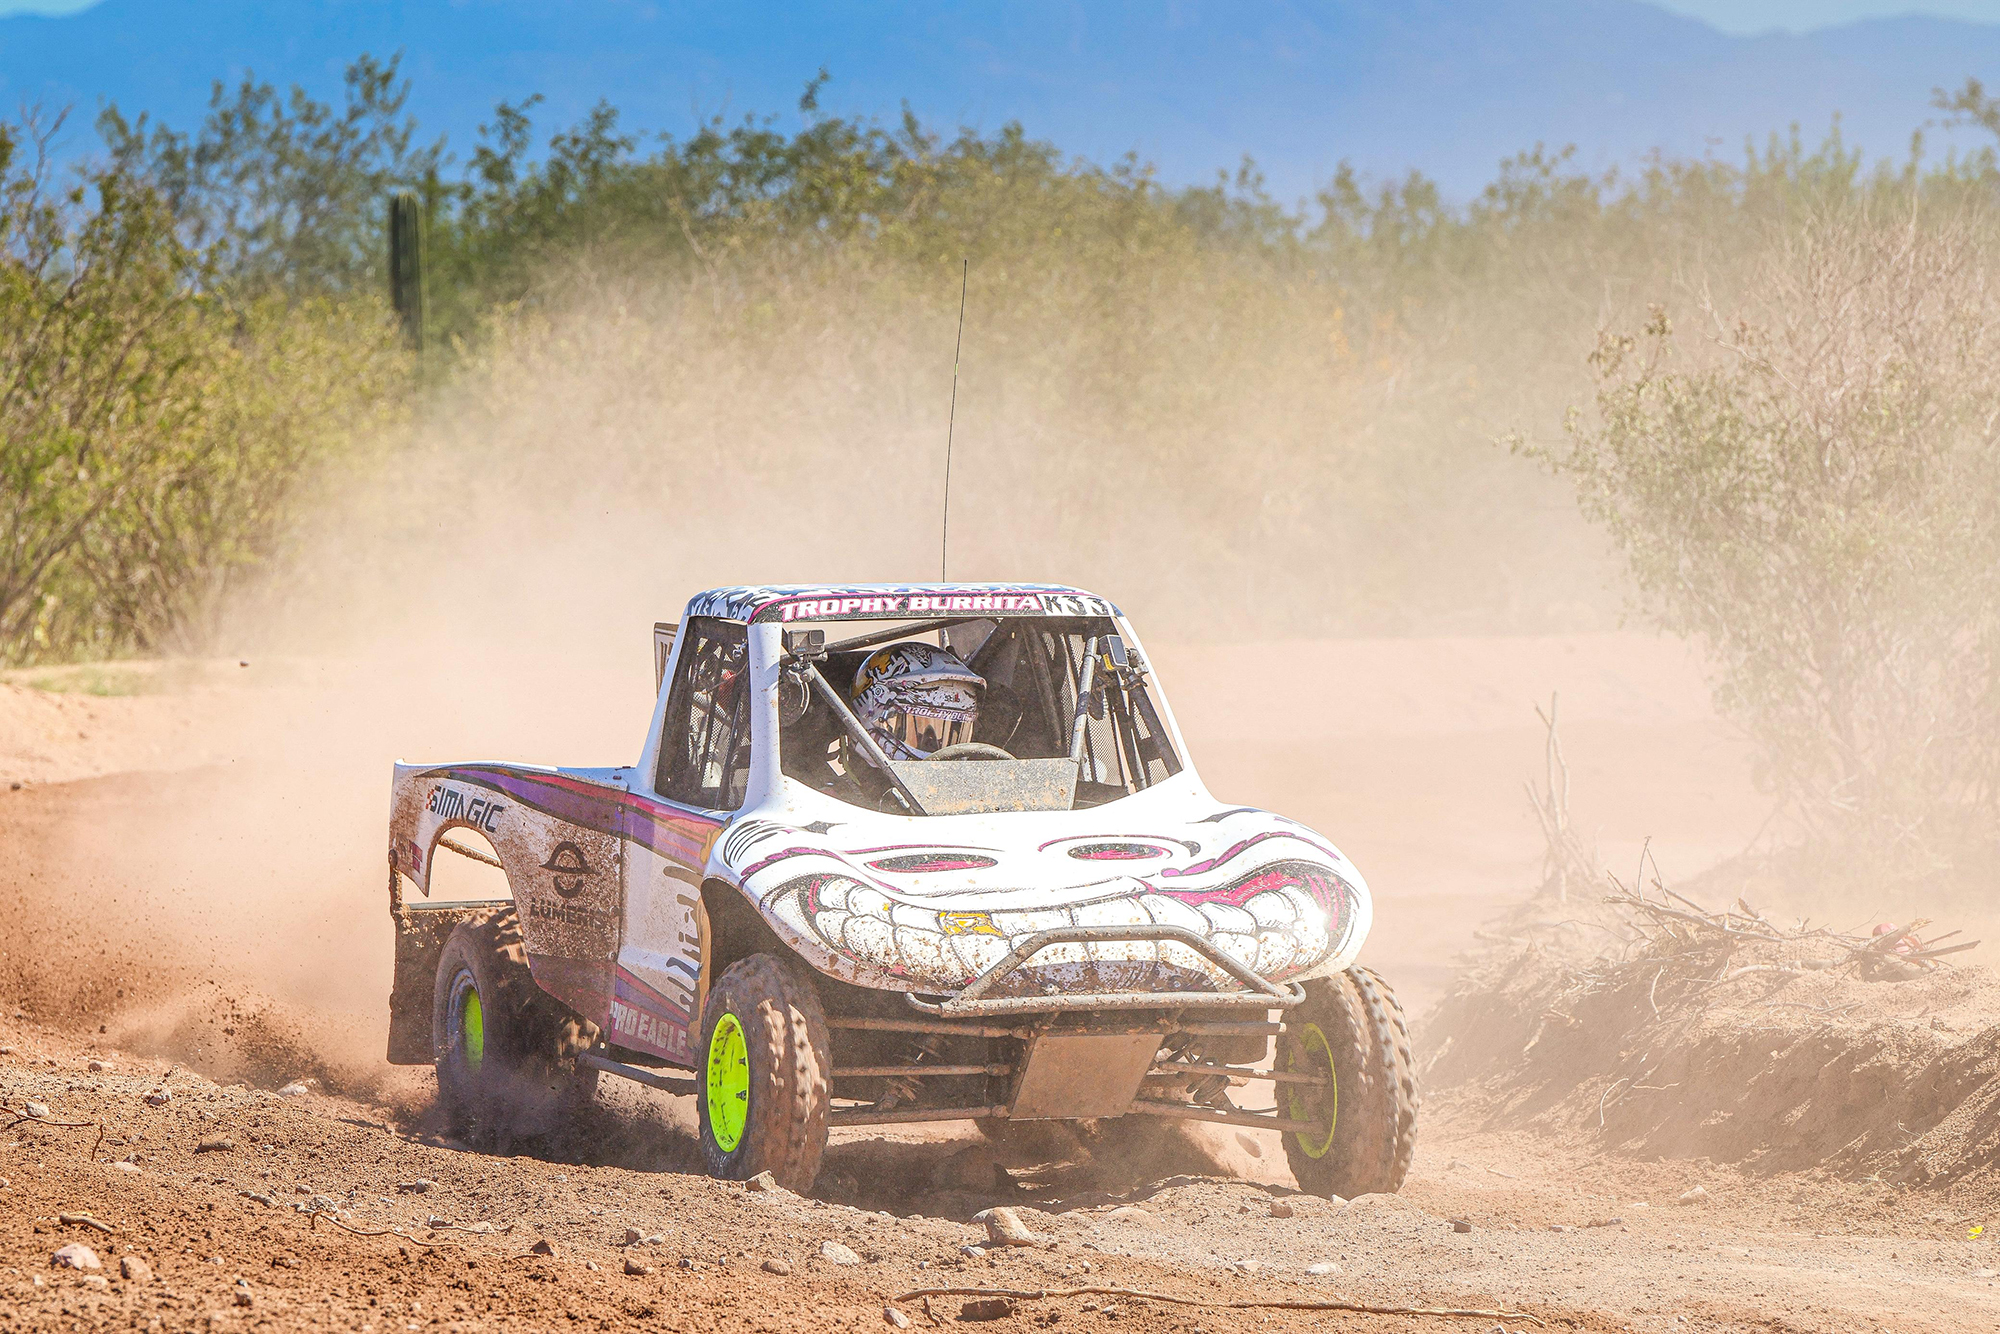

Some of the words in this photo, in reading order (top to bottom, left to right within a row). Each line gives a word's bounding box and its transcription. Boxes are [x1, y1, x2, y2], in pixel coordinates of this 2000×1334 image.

[779, 597, 902, 622] TROPHY
[907, 596, 1043, 612] BURRITA
[426, 785, 504, 833] SIMAGIC
[609, 1000, 638, 1036] PRO
[638, 1013, 687, 1058] EAGLE
